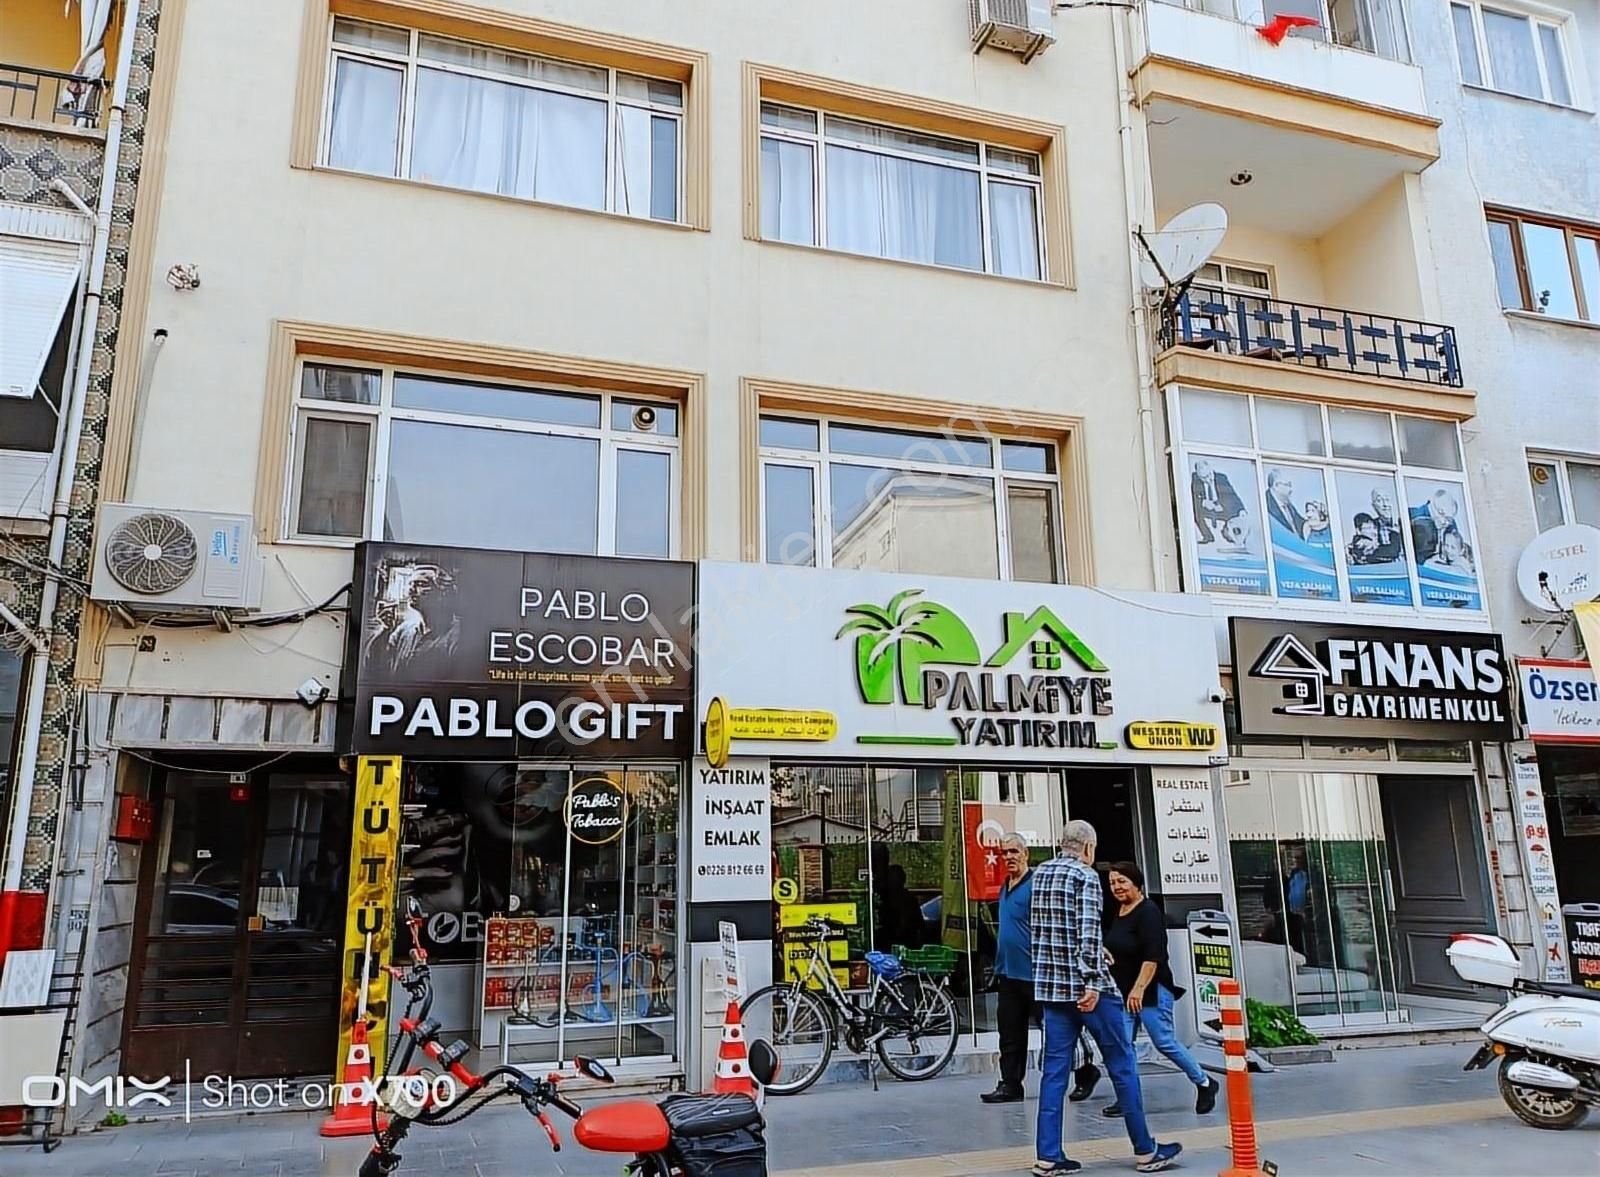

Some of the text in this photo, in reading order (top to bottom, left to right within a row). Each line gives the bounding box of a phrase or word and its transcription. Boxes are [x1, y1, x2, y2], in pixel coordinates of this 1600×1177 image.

[520, 587, 650, 622] PABLO
[488, 631, 675, 667] ESCOBAR
[1327, 638, 1503, 693] FİNANS
[1333, 692, 1504, 722] GAYRİMENKUL
[370, 696, 555, 739] PABLO
[570, 701, 684, 740] GIFT
[952, 716, 1100, 749] YATIRIM
[1132, 727, 1182, 736] WESTERN
[1149, 736, 1183, 746] UNION
[700, 769, 765, 785] YATIRIM
[1157, 779, 1209, 790] REAL ESTATE
[573, 792, 621, 809] Pablo's
[705, 796, 765, 819] İNŞAAT
[571, 812, 623, 828] Tobacco
[705, 830, 761, 846] EMLAK
